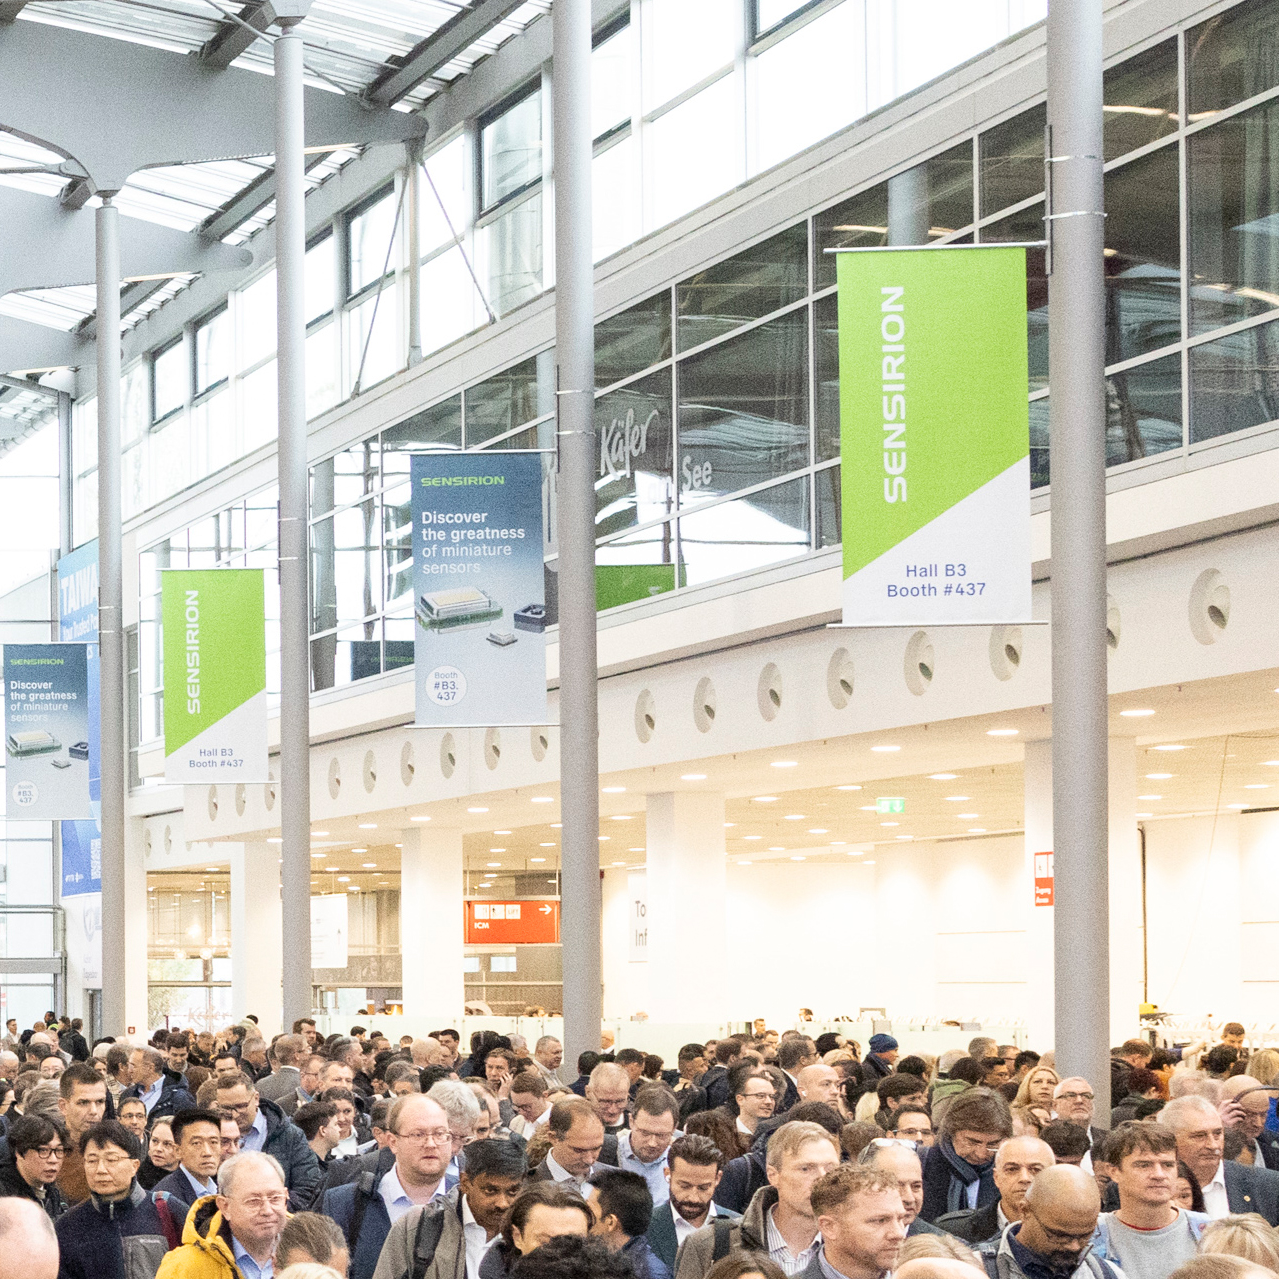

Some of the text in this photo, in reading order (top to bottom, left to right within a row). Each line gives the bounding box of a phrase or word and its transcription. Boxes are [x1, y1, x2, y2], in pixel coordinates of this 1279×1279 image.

[881, 286, 907, 503] SENSIRION
[600, 408, 659, 481] Käfer
[682, 456, 712, 492] See
[421, 475, 505, 487] SENSIRION
[422, 511, 488, 524] Discover
[421, 527, 525, 543] the greatness
[422, 544, 512, 557] of miniature
[422, 562, 481, 574] sensors
[906, 563, 967, 577] Hall B3
[887, 582, 986, 597] Booth #437
[185, 590, 201, 715] SENSIRION
[10, 681, 53, 690] Discover
[434, 681, 459, 690] #B3.
[10, 691, 77, 702] the greatness
[437, 692, 456, 701] 437
[10, 702, 68, 711] of miniature
[11, 714, 48, 722] sensors
[199, 749, 233, 757] Hall B3
[189, 759, 244, 768] Booth #437
